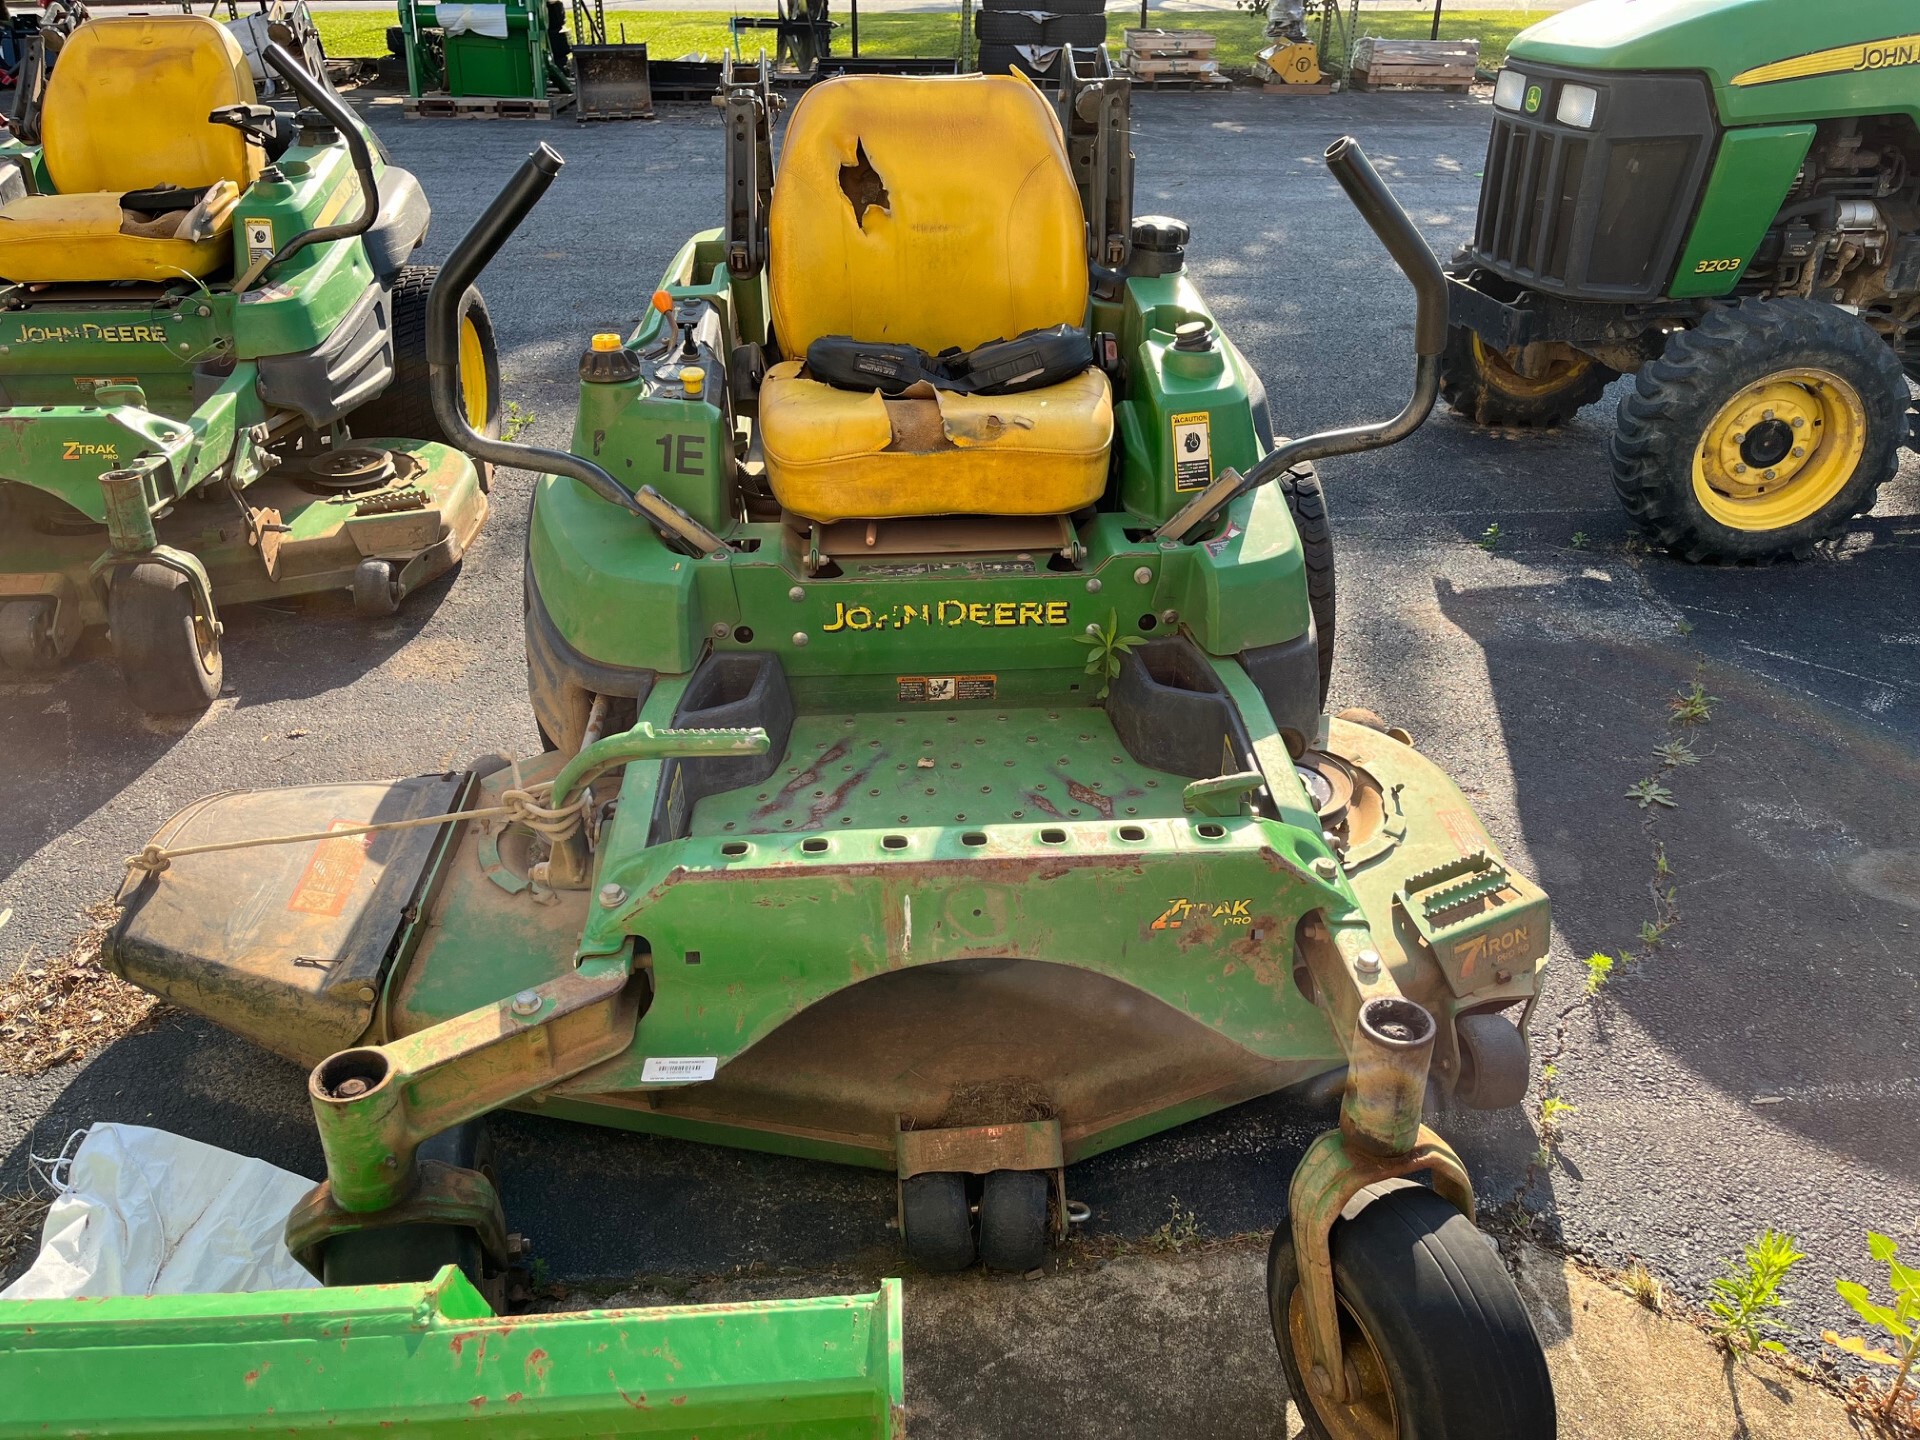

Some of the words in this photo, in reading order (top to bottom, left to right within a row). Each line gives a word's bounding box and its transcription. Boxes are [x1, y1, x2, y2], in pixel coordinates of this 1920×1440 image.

[1853, 45, 1912, 70] JOHN
[1694, 258, 1741, 273] 3203
[15, 324, 80, 343] JOHN
[82, 323, 168, 343] DEERE
[1180, 414, 1207, 423] CAUTION
[63, 441, 116, 460] ZTRAK
[656, 433, 705, 476] 1E
[937, 600, 1070, 628] DEERE
